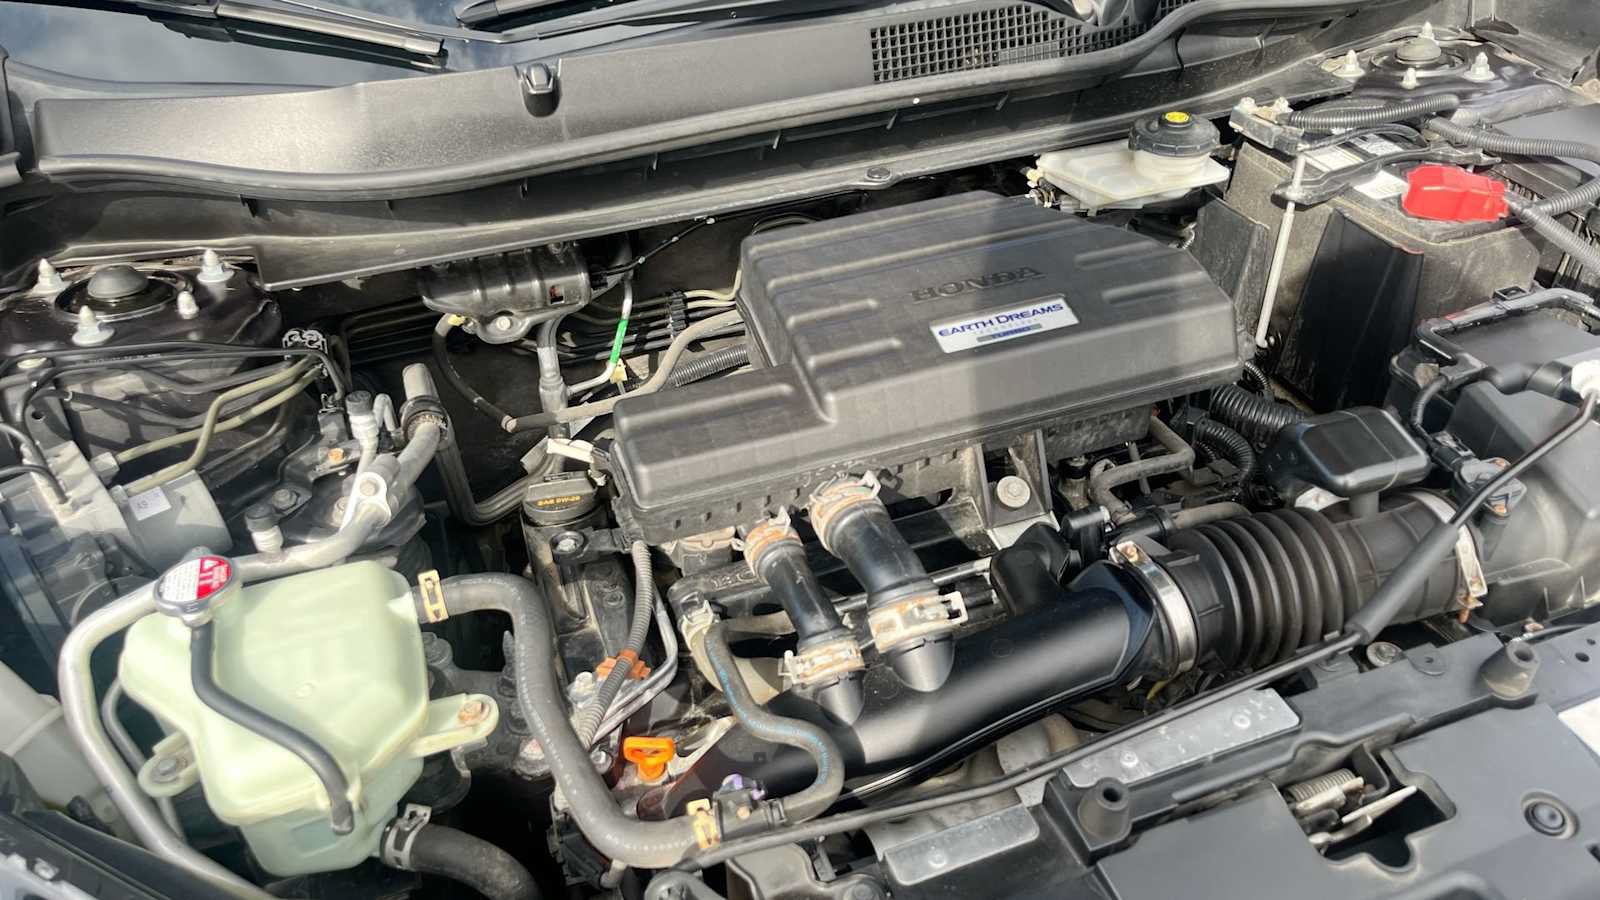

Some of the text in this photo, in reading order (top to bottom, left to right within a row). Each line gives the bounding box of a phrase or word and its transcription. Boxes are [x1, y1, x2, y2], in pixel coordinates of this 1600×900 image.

[911, 266, 1046, 303] HONDA
[938, 319, 994, 337] EARTH
[995, 303, 1064, 324] DREAMS
